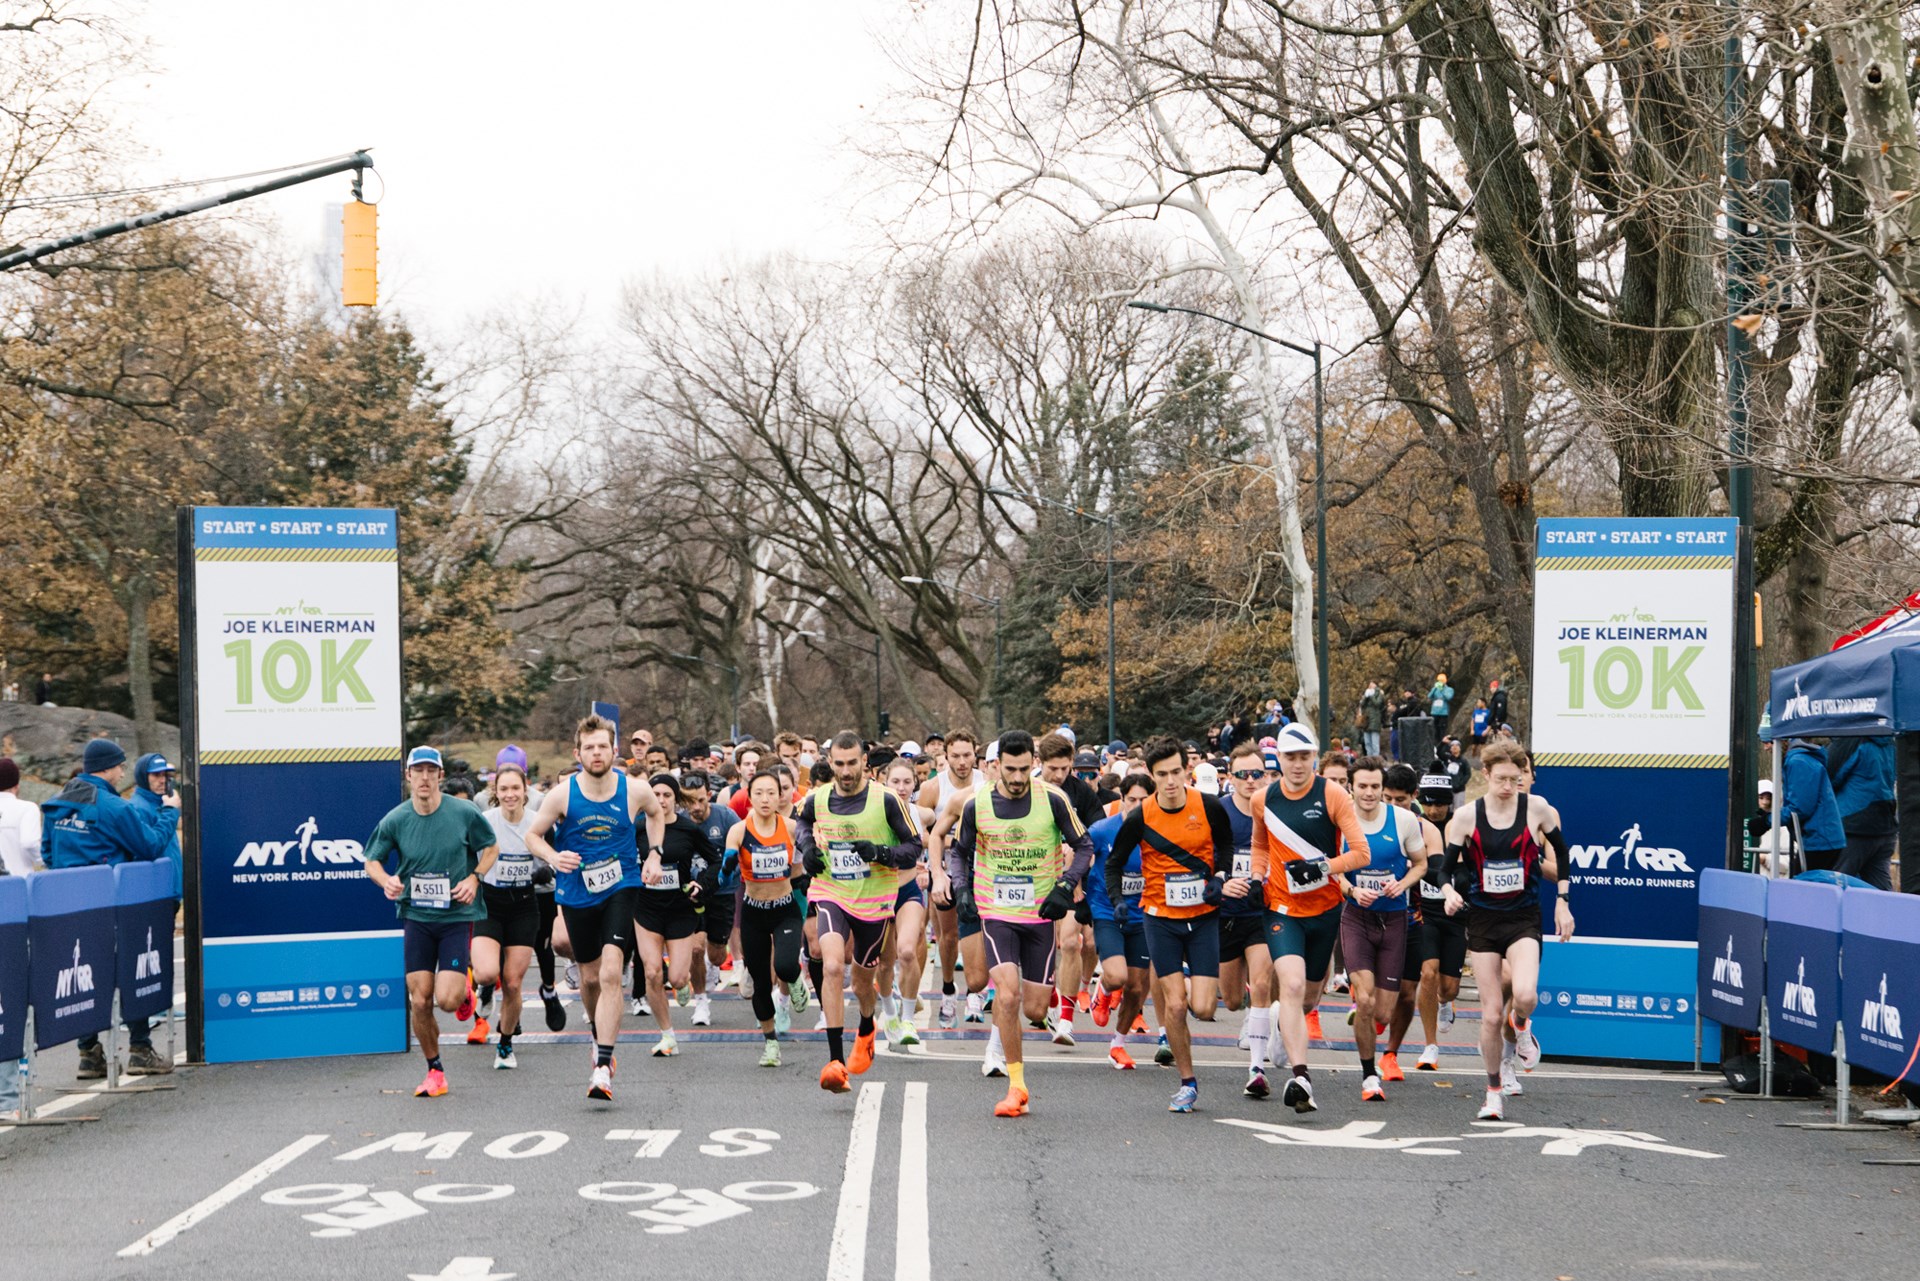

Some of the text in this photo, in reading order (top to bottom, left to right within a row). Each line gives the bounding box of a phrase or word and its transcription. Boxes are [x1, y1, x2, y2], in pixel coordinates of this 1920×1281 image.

[203, 521, 388, 535] START START START
[1546, 532, 1727, 544] START START START
[223, 620, 375, 634] JOE KLEINERMAN
[1558, 628, 1708, 640] JOE KLEINERMAN
[224, 639, 375, 704] 10K
[1558, 646, 1706, 710] 10K
[764, 857, 784, 868] 1290
[842, 855, 861, 867] 658
[507, 866, 528, 876] 6269
[232, 874, 258, 883] NEW
[260, 872, 289, 882] YORK
[292, 872, 321, 881] ROAD
[588, 869, 616, 888] A 233
[1494, 874, 1519, 886] 5502
[1584, 876, 1612, 885] YORK
[1614, 877, 1644, 886] ROAD
[1646, 878, 1696, 888] RUNNERS
[414, 884, 444, 895] A 5511
[1123, 880, 1142, 890] 1470
[1008, 888, 1026, 900] 657
[1182, 886, 1198, 899] 514
[748, 895, 792, 910] NIKE PRO
[332, 1127, 782, 1160] SLOW
